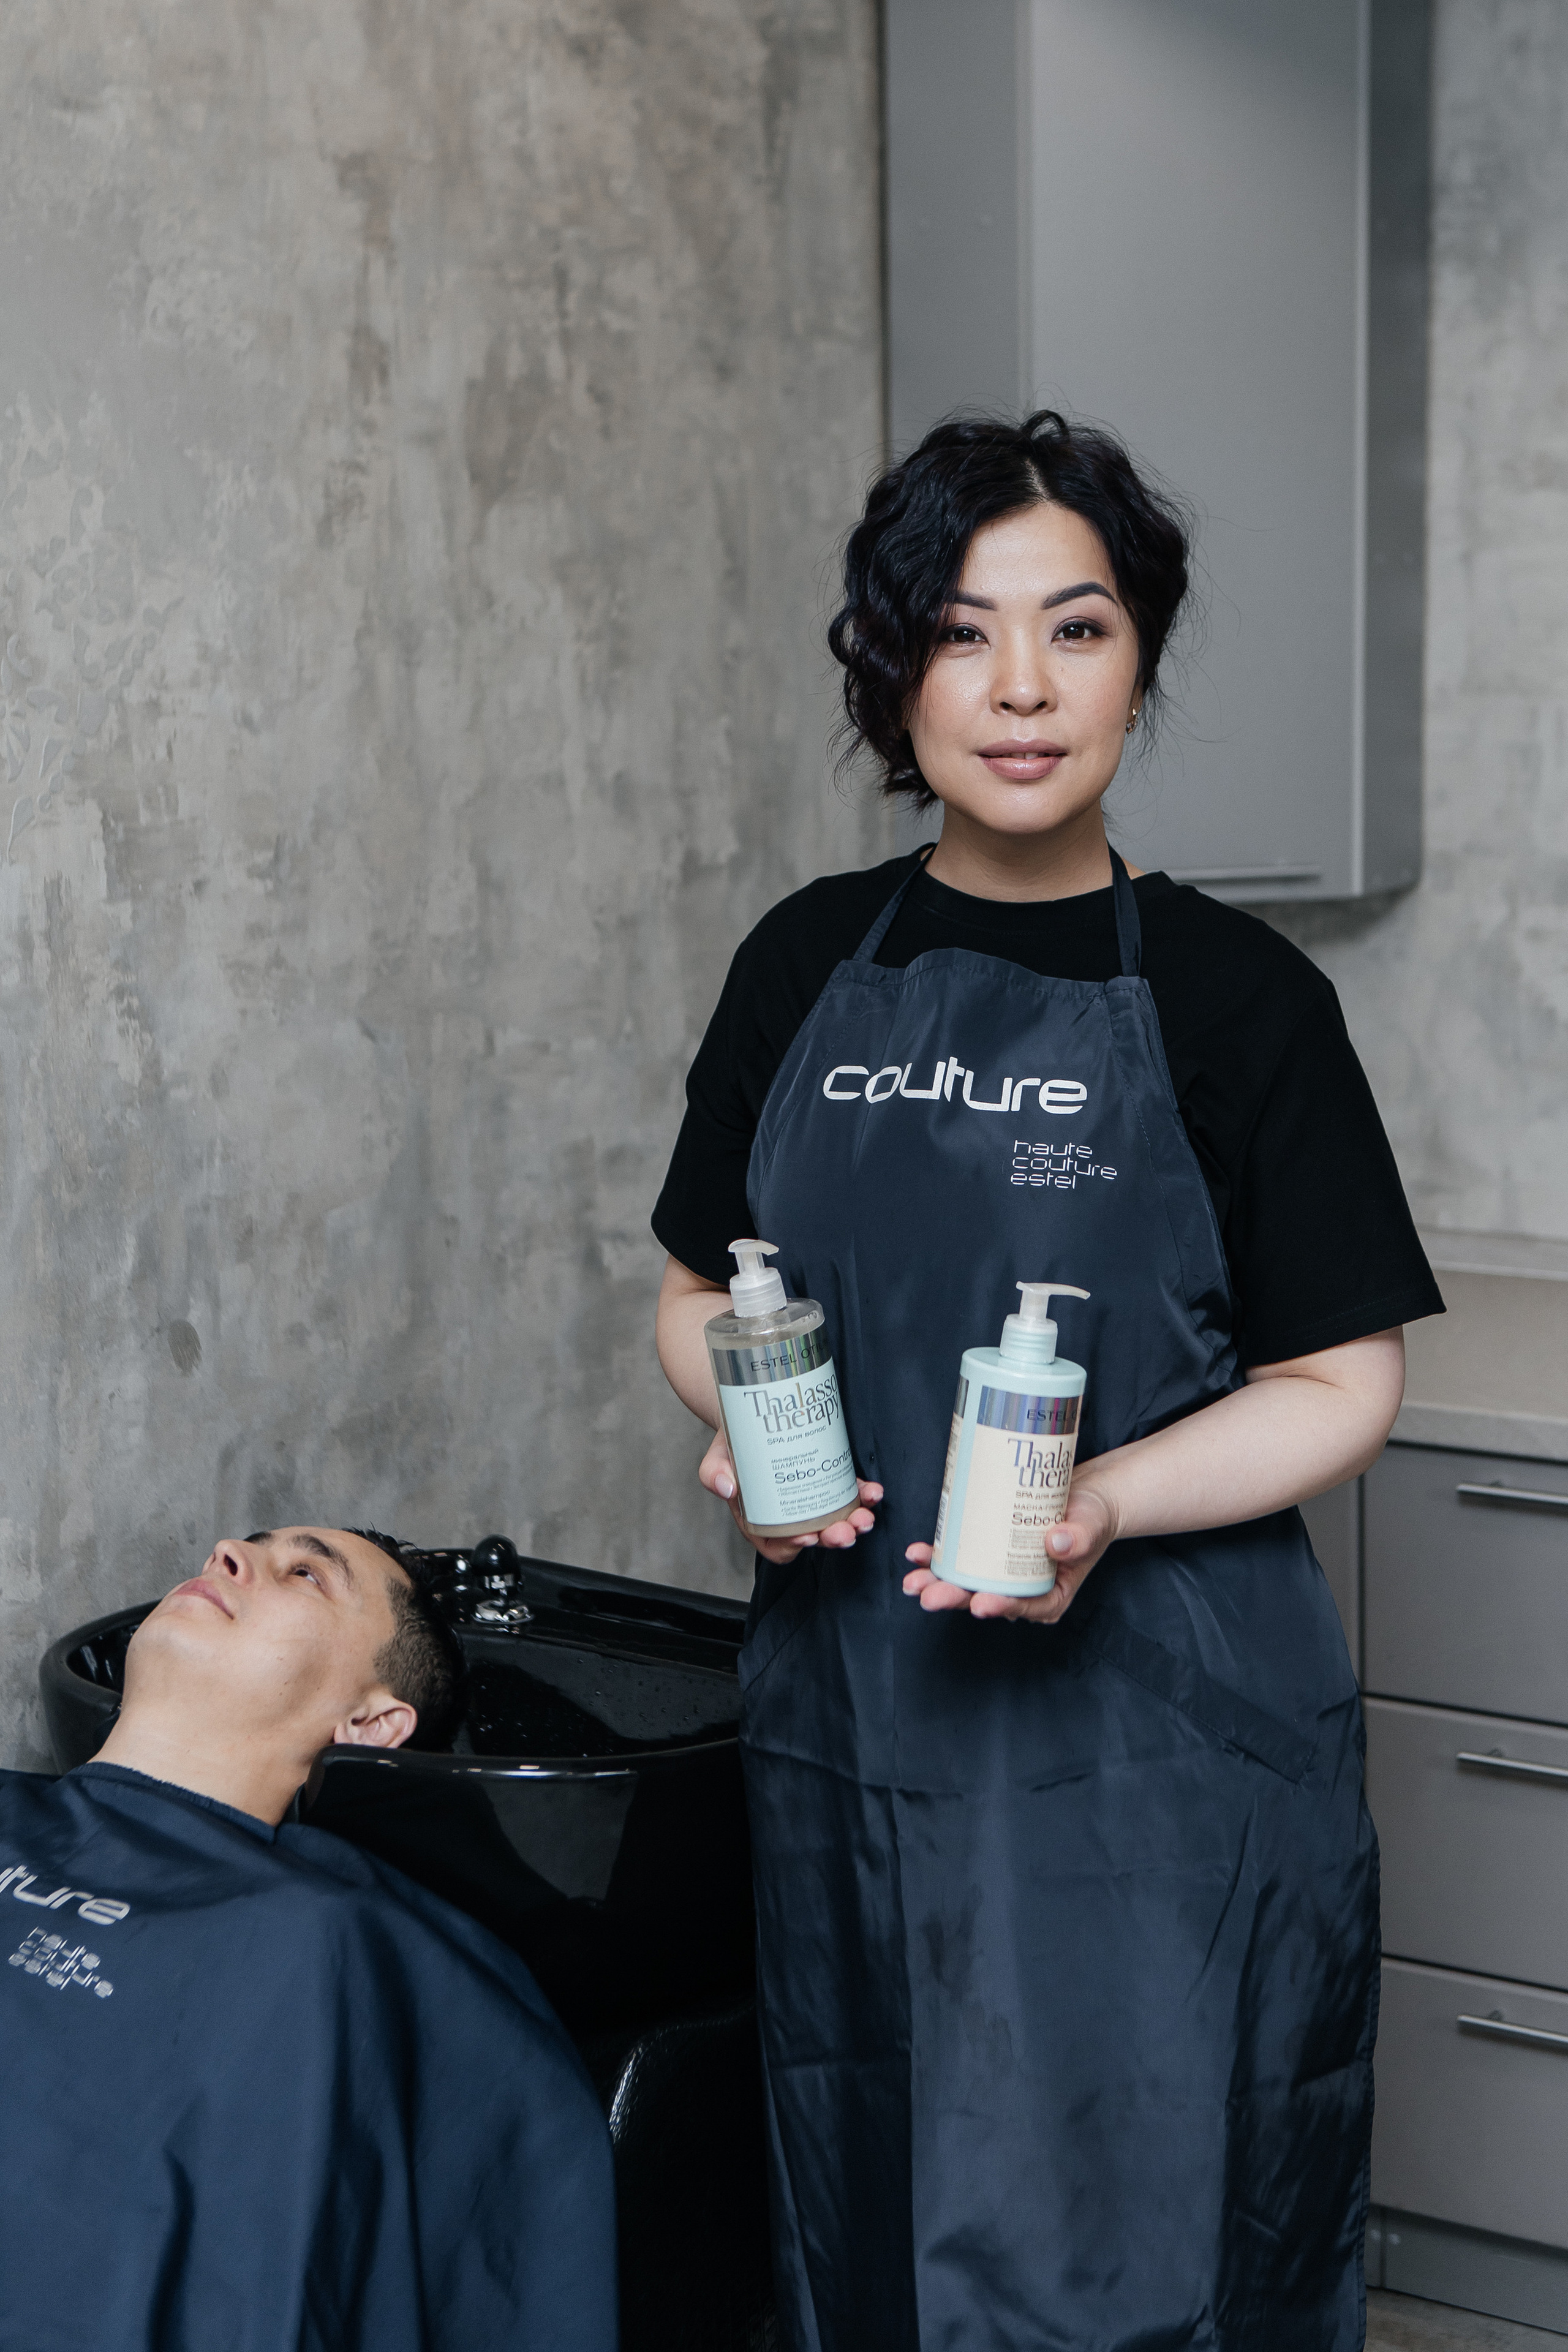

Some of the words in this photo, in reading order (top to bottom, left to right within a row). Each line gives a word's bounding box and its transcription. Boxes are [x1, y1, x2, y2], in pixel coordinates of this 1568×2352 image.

[823, 1056, 1088, 1115] couture
[1013, 1140, 1093, 1158] haute
[1012, 1156, 1118, 1180] couture
[1011, 1172, 1076, 1189] estel
[750, 1353, 797, 1372] ESTEL
[801, 1340, 827, 1359] OTIU
[744, 1373, 837, 1418] Thalasso
[763, 1391, 839, 1434] therapy
[1027, 1409, 1069, 1422] ESTEL
[766, 1436, 785, 1446] SPA
